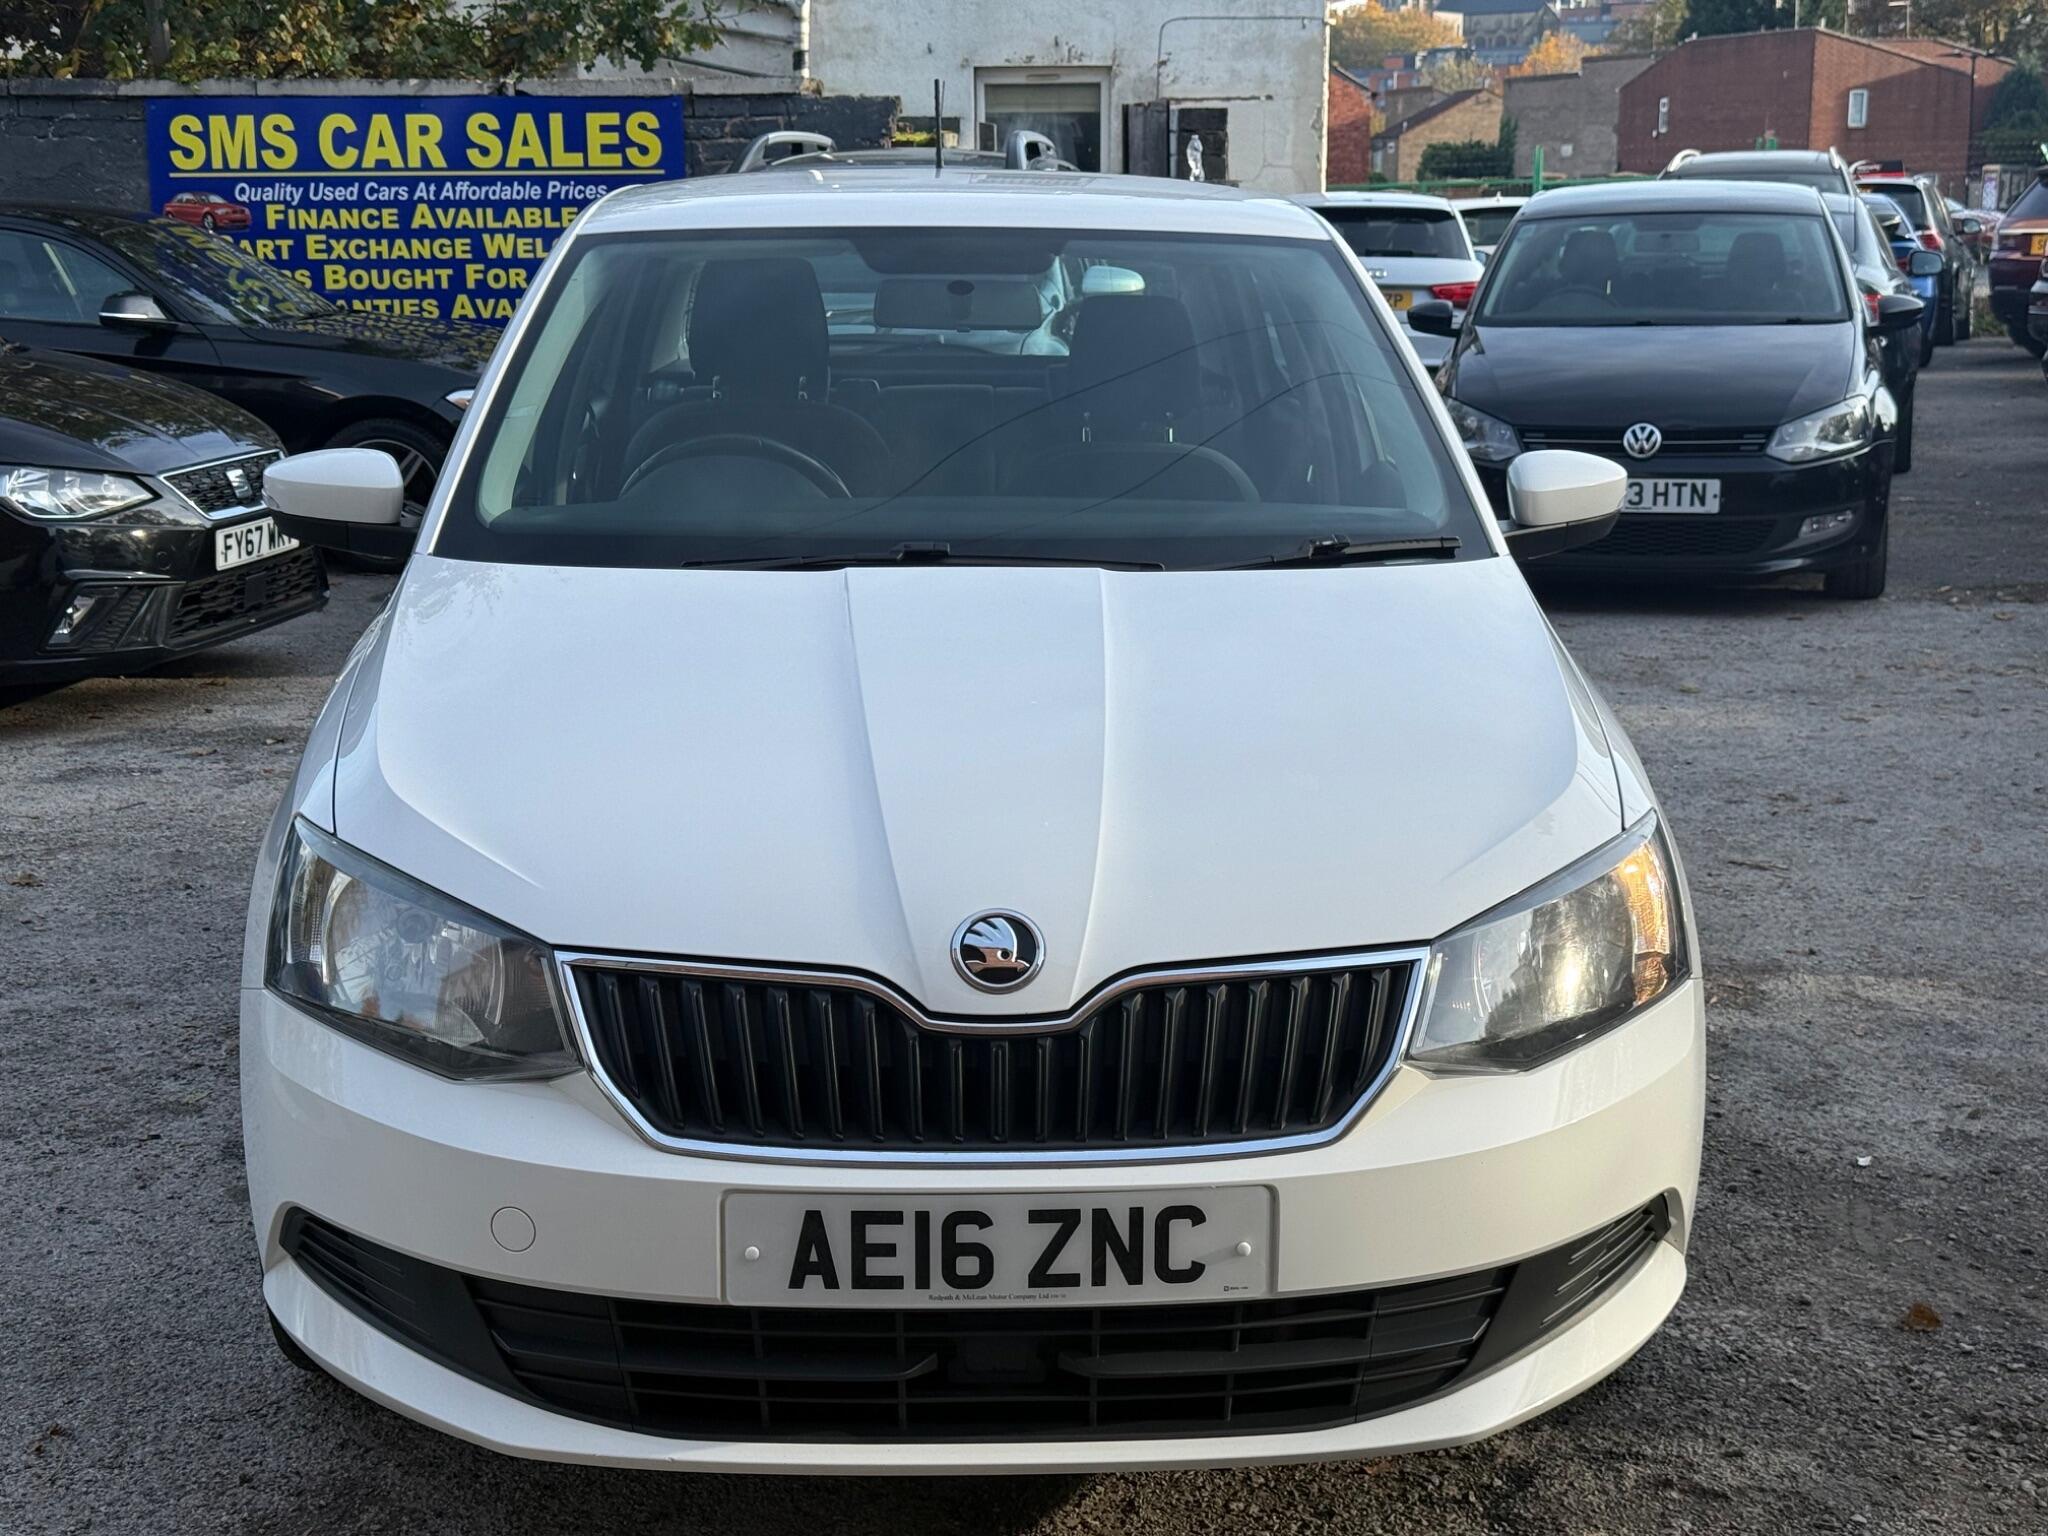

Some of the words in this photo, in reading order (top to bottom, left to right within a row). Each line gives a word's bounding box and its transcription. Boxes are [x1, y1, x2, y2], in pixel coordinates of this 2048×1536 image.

[169, 114, 298, 170] SMS
[318, 113, 448, 169] CAR
[466, 111, 662, 168] SALES
[234, 183, 304, 205] Quality
[309, 182, 359, 201] Used
[364, 182, 409, 200] Cars
[414, 182, 436, 200] At
[440, 181, 542, 200] Affordable
[547, 181, 607, 199] Prices
[266, 204, 400, 230] FINANCE
[411, 203, 578, 229] AVAILABLE
[221, 235, 294, 260] ART
[306, 234, 472, 260] EXCHANGE
[482, 233, 559, 259] WEL
[324, 264, 453, 290] BOUGHT
[465, 264, 528, 289] FOR
[451, 294, 521, 319] AVA
[1652, 482, 1707, 507] HTN
[223, 525, 263, 562] FY67
[787, 1209, 994, 1290] AE16
[1028, 1204, 1207, 1288] ZNC
